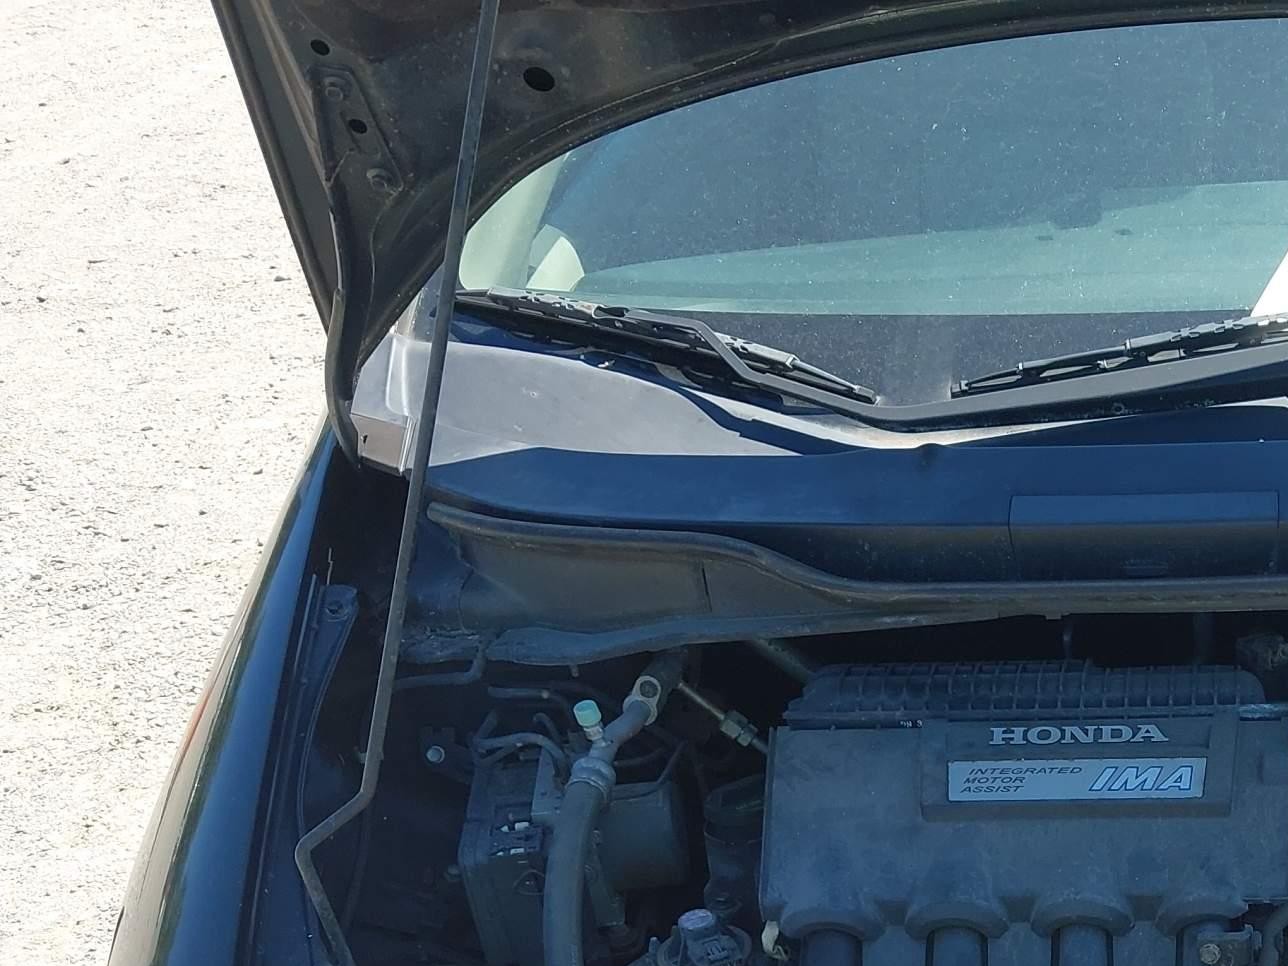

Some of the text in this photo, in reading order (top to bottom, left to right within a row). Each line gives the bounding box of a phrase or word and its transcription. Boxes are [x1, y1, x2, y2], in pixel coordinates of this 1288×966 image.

[989, 724, 1169, 746] HONDA
[968, 766, 1083, 776] INTEGRATED
[963, 776, 1026, 785] MOTOR
[1088, 765, 1195, 792] IMA
[960, 785, 1025, 794] ASSIST
